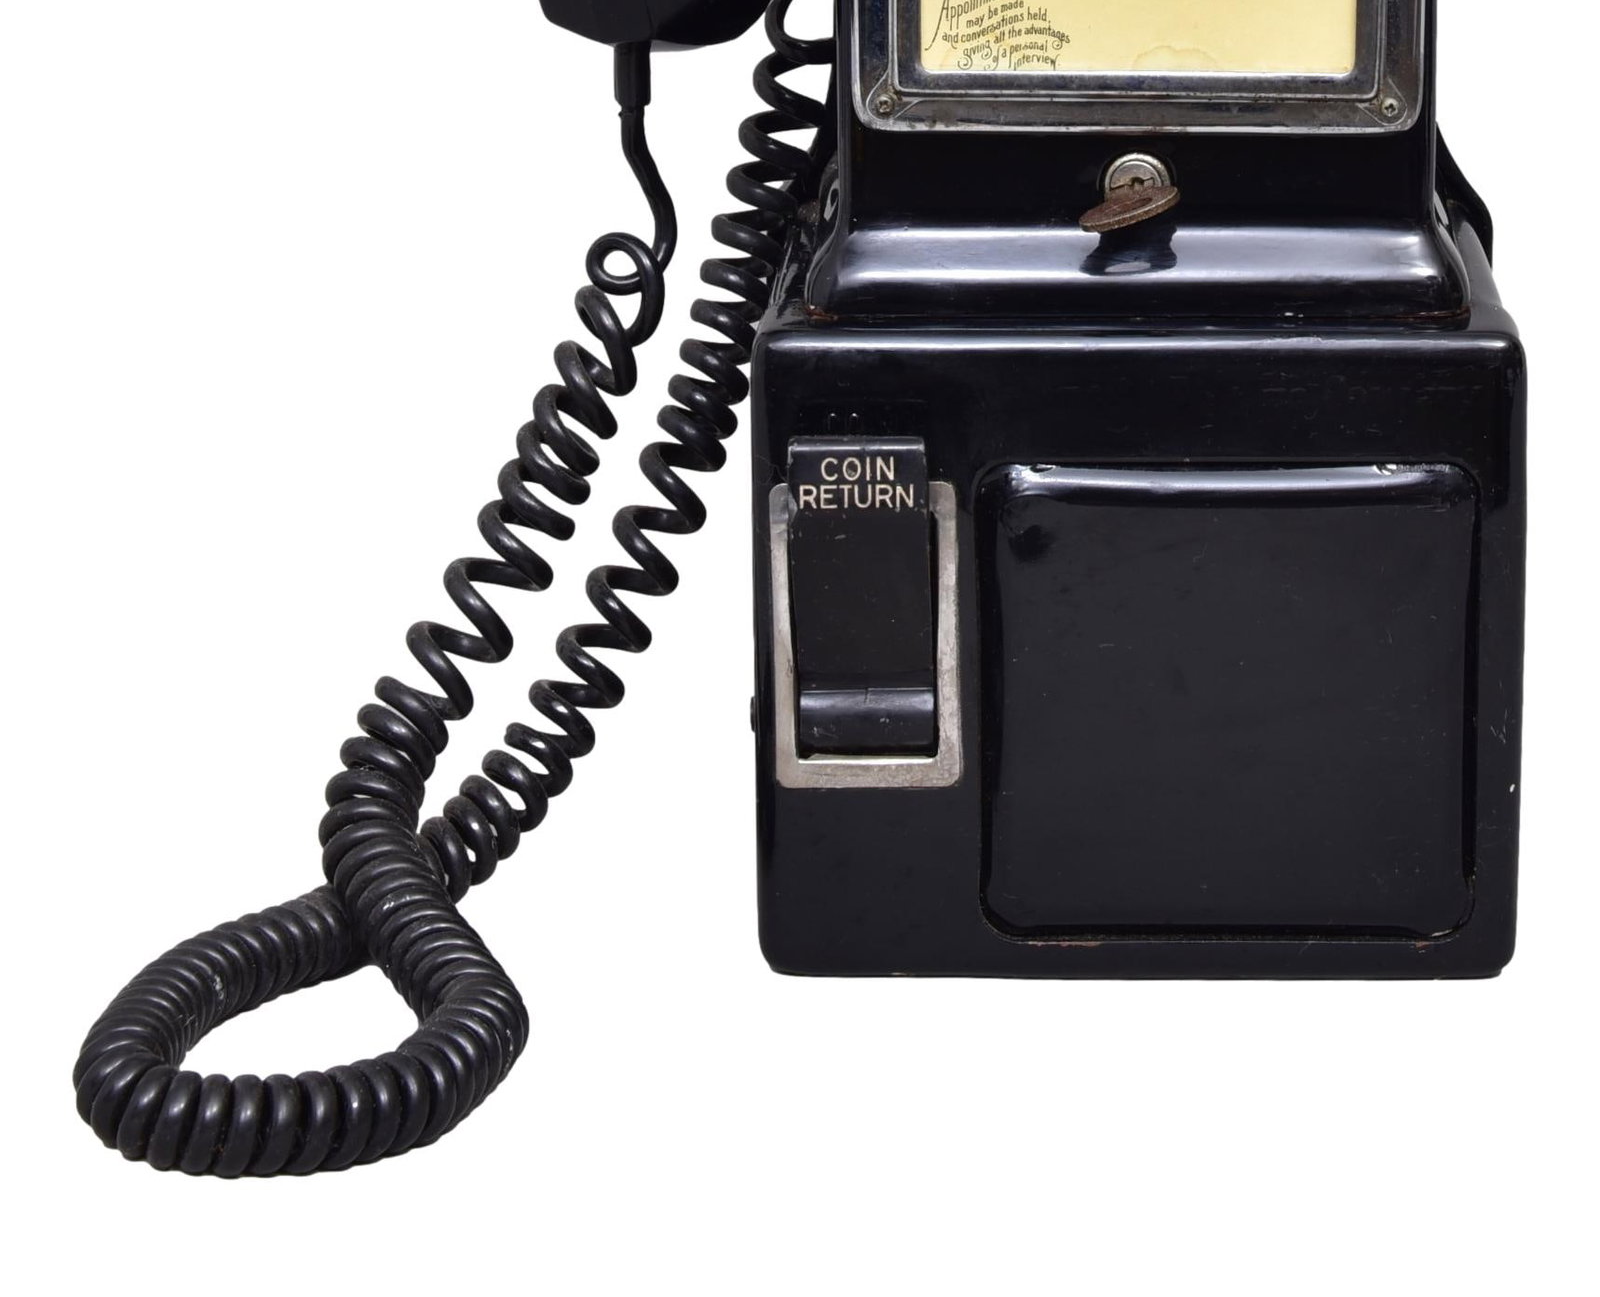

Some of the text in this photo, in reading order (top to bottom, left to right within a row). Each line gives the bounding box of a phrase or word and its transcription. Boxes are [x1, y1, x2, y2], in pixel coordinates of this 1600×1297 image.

[942, 32, 959, 49] and
[960, 12, 1025, 43] conversations
[966, 14, 985, 29] may
[988, 5, 999, 20] be
[957, 23, 1071, 70] giving all the advantages
[1008, 39, 1048, 69] personal
[820, 456, 895, 482] COIN
[799, 484, 914, 510] RETURN
